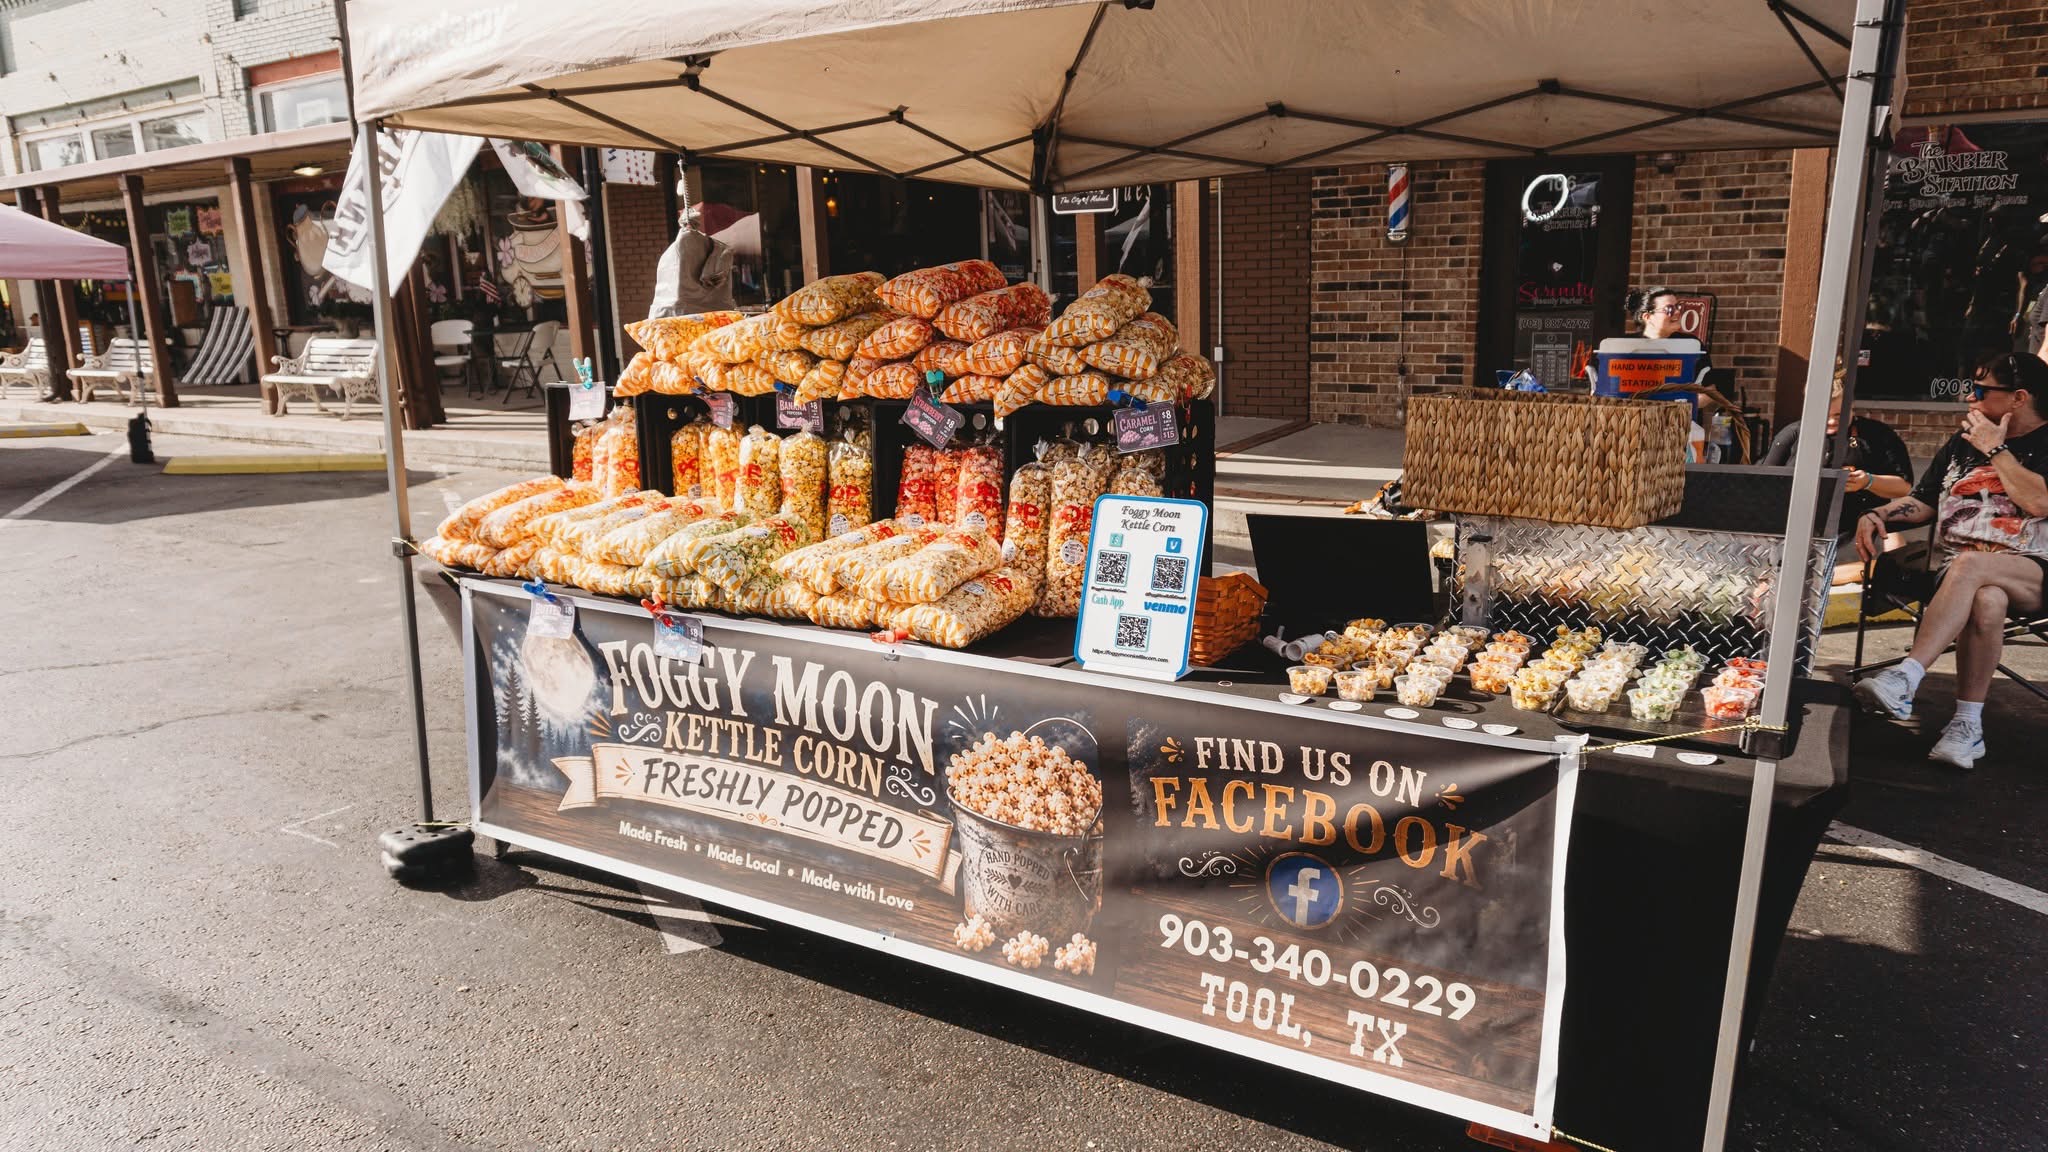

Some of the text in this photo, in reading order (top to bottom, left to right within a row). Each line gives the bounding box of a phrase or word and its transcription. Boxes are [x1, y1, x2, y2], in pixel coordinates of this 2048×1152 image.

[1911, 141, 1945, 160] The
[1897, 151, 2008, 184] BARBER
[1920, 173, 2019, 196] STATION
[1611, 363, 1681, 371] HAND WASHING
[1621, 379, 1661, 387] STATION
[1120, 415, 1158, 432] CARAMEL
[1161, 410, 1172, 419] $8
[1140, 425, 1154, 433] CORN
[1162, 430, 1175, 439] $15
[1121, 505, 1181, 519] Foggy Moon
[1121, 519, 1176, 533] Kettle Corn
[1092, 593, 1109, 606] Cash
[1143, 601, 1187, 615] venmo
[690, 628, 699, 638] $8
[598, 640, 939, 776] FOGGY MOON
[663, 711, 885, 798] KETTLE CORN
[1194, 737, 1428, 808] FIND US ON
[642, 757, 904, 850] FRESHLY POPPED
[1149, 777, 1488, 890] FACEBOOK
[619, 821, 915, 912] Made Fresh Made Local Made with Love
[986, 851, 1050, 880] HAND POPPED
[987, 885, 1042, 916] WITH CARE
[1159, 914, 1477, 1021] 903-340-0229
[1200, 972, 1408, 1068] TOOL, TX
